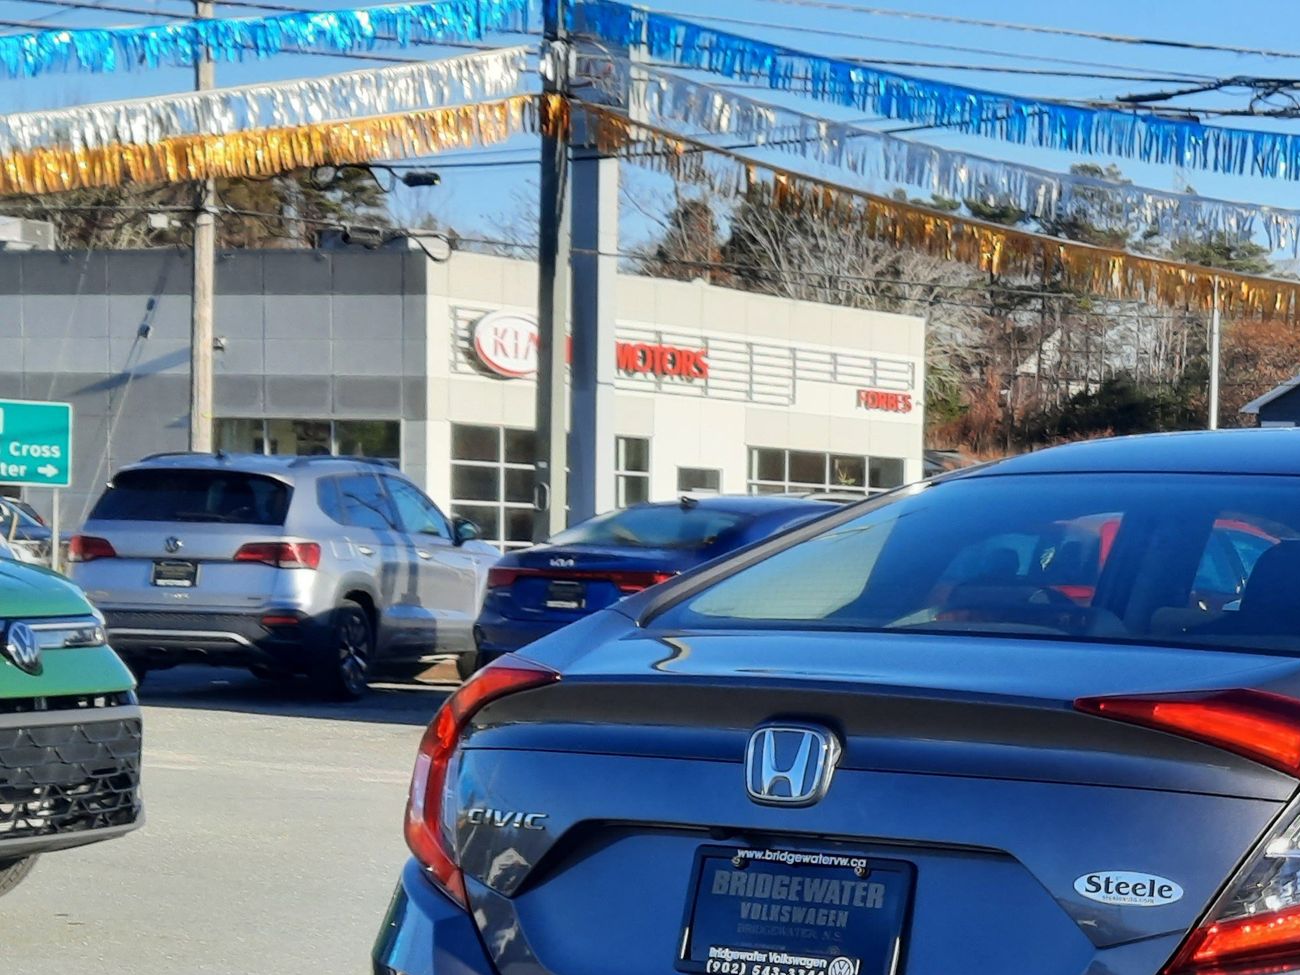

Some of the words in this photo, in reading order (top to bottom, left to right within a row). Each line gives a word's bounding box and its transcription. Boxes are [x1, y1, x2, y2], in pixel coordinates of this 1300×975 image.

[615, 340, 710, 379] MOTORS
[856, 389, 912, 413] FORBES
[9, 441, 62, 458] Cross
[466, 807, 549, 830] CIVIC
[737, 849, 866, 868] www.bridgewatervw.ca
[712, 870, 886, 908] BRIDGEWATER
[1085, 875, 1173, 899] Steele
[740, 902, 848, 928] VOLKSWAGEN
[706, 959, 747, 975] (902)
[709, 947, 768, 962] Bridgewater
[769, 951, 828, 969] Volkswagen
